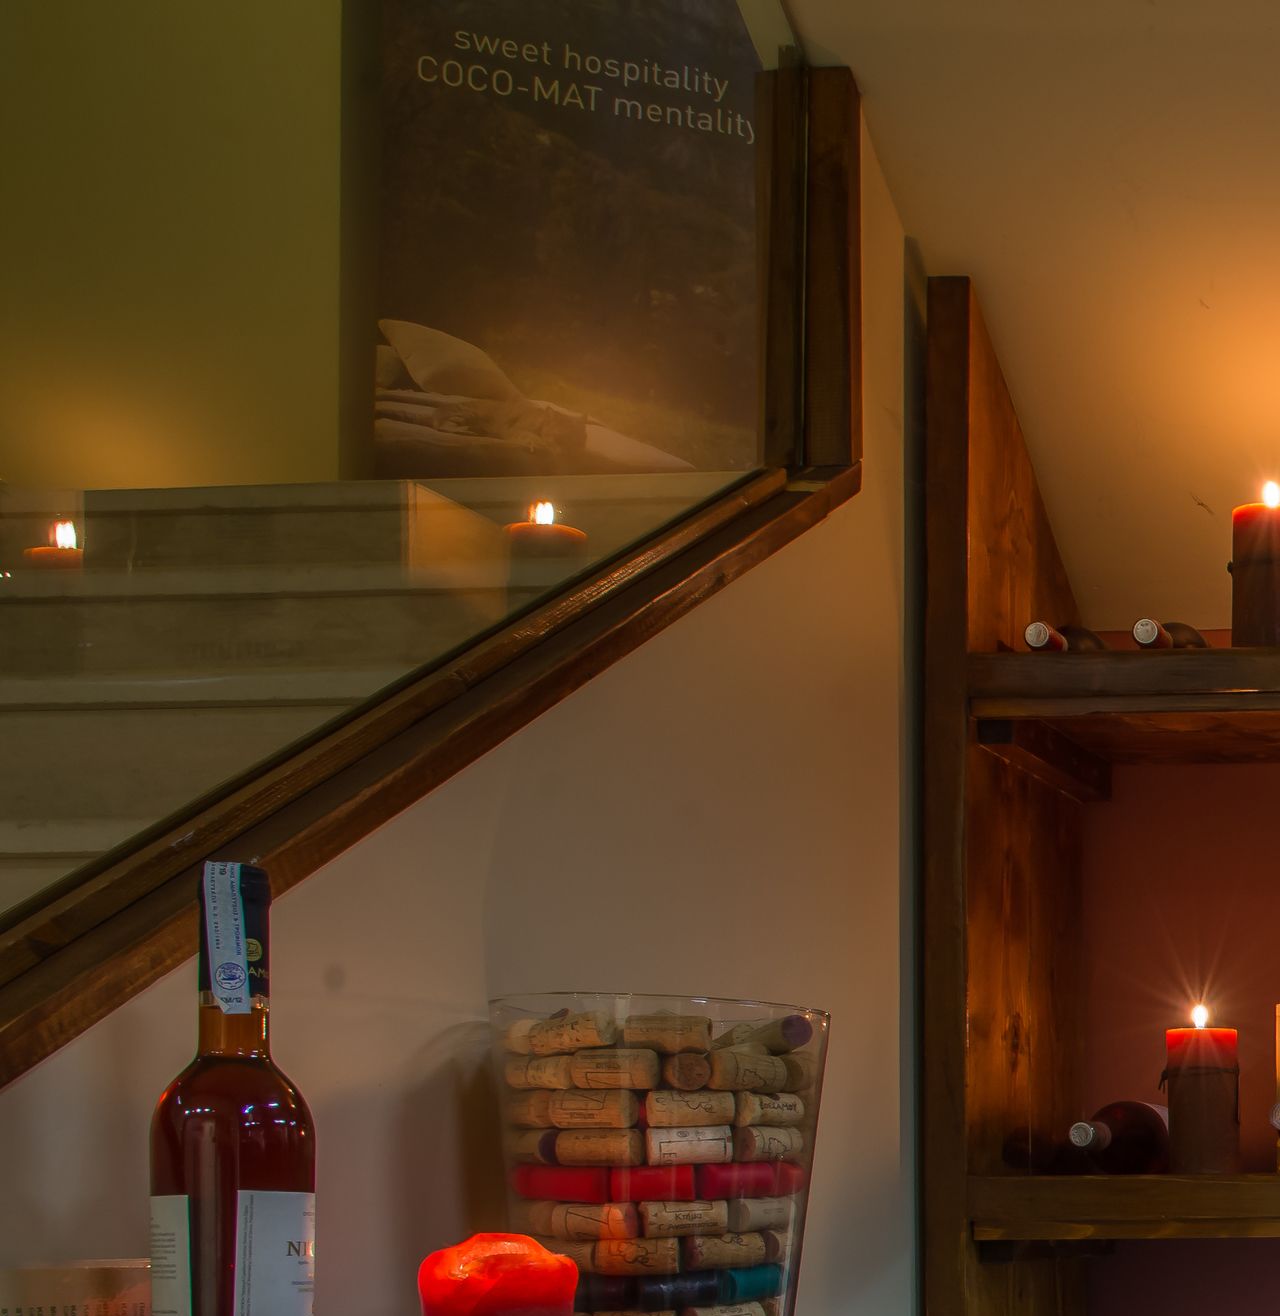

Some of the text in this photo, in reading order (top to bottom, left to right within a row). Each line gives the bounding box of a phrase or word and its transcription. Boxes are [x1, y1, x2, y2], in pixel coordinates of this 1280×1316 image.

[417, 55, 756, 144] COCO-MAT mentality
[454, 30, 730, 102] sweet hospitality
